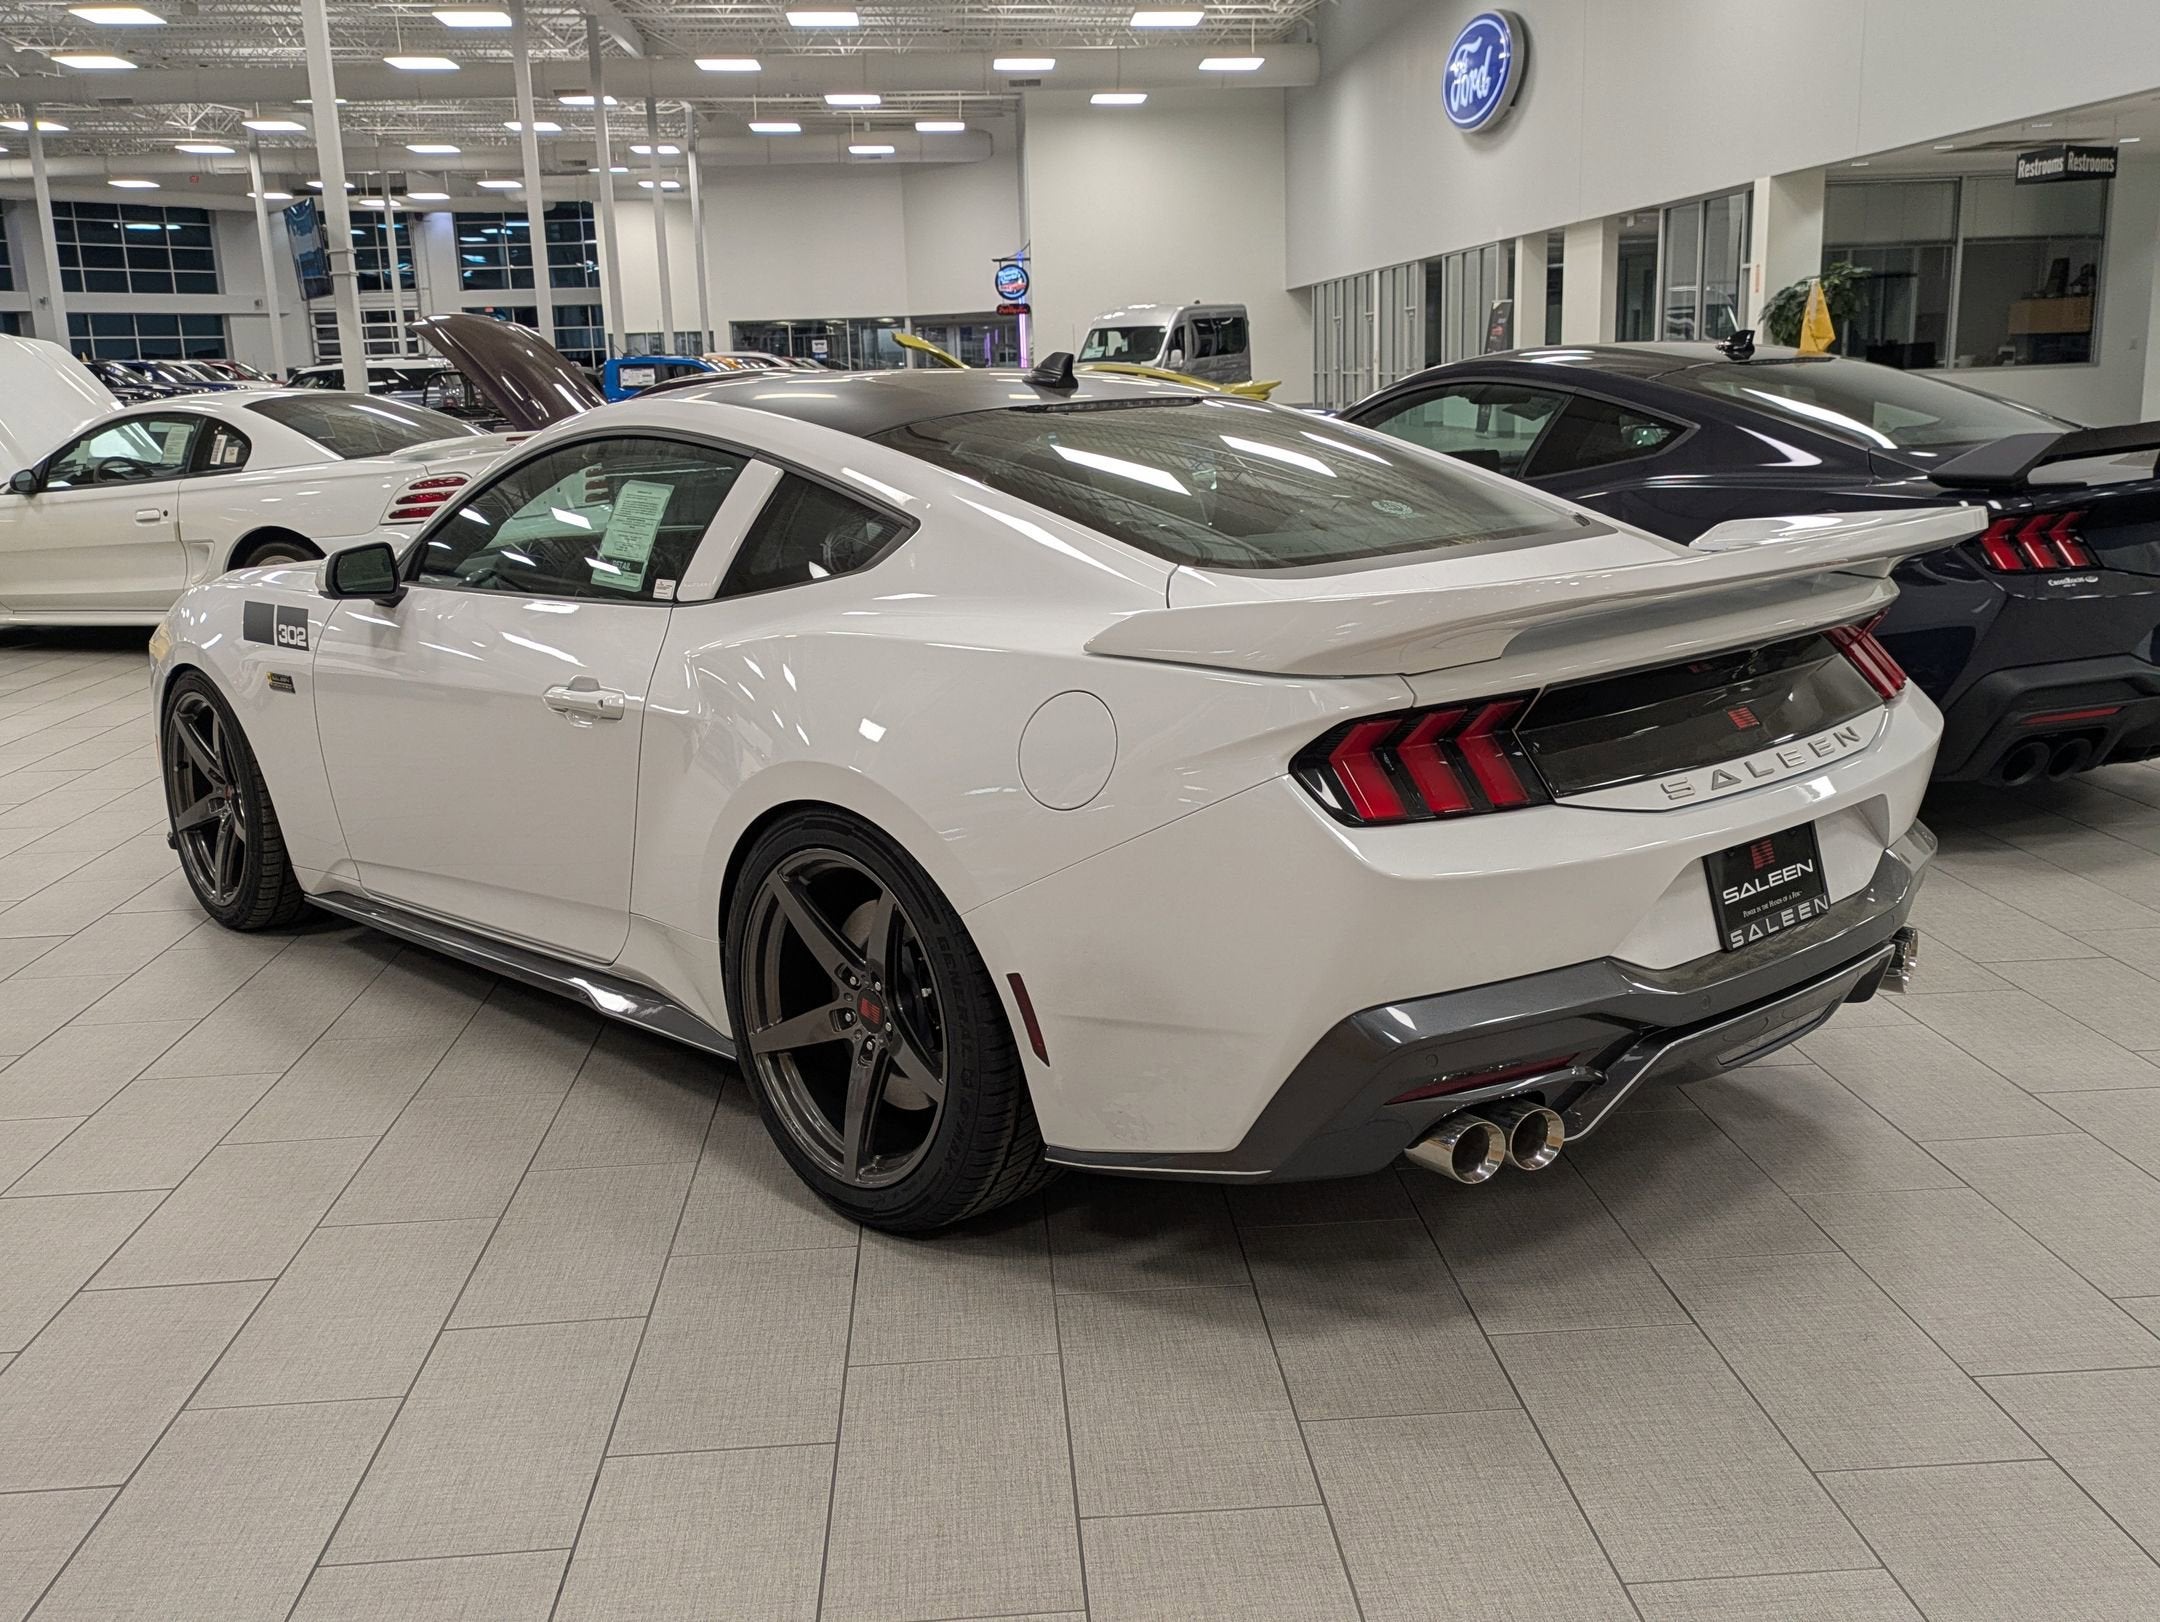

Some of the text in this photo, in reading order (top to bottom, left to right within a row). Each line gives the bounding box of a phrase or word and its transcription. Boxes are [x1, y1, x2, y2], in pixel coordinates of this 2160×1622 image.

[1450, 37, 1493, 112] Ford
[2018, 157, 2064, 179] Restrooms
[2067, 151, 2115, 172] Restrooms
[278, 624, 307, 647] 302
[1661, 726, 1862, 801] SALEEN
[1723, 859, 1814, 905] SALEEN
[1730, 895, 1830, 949] SALEEN
